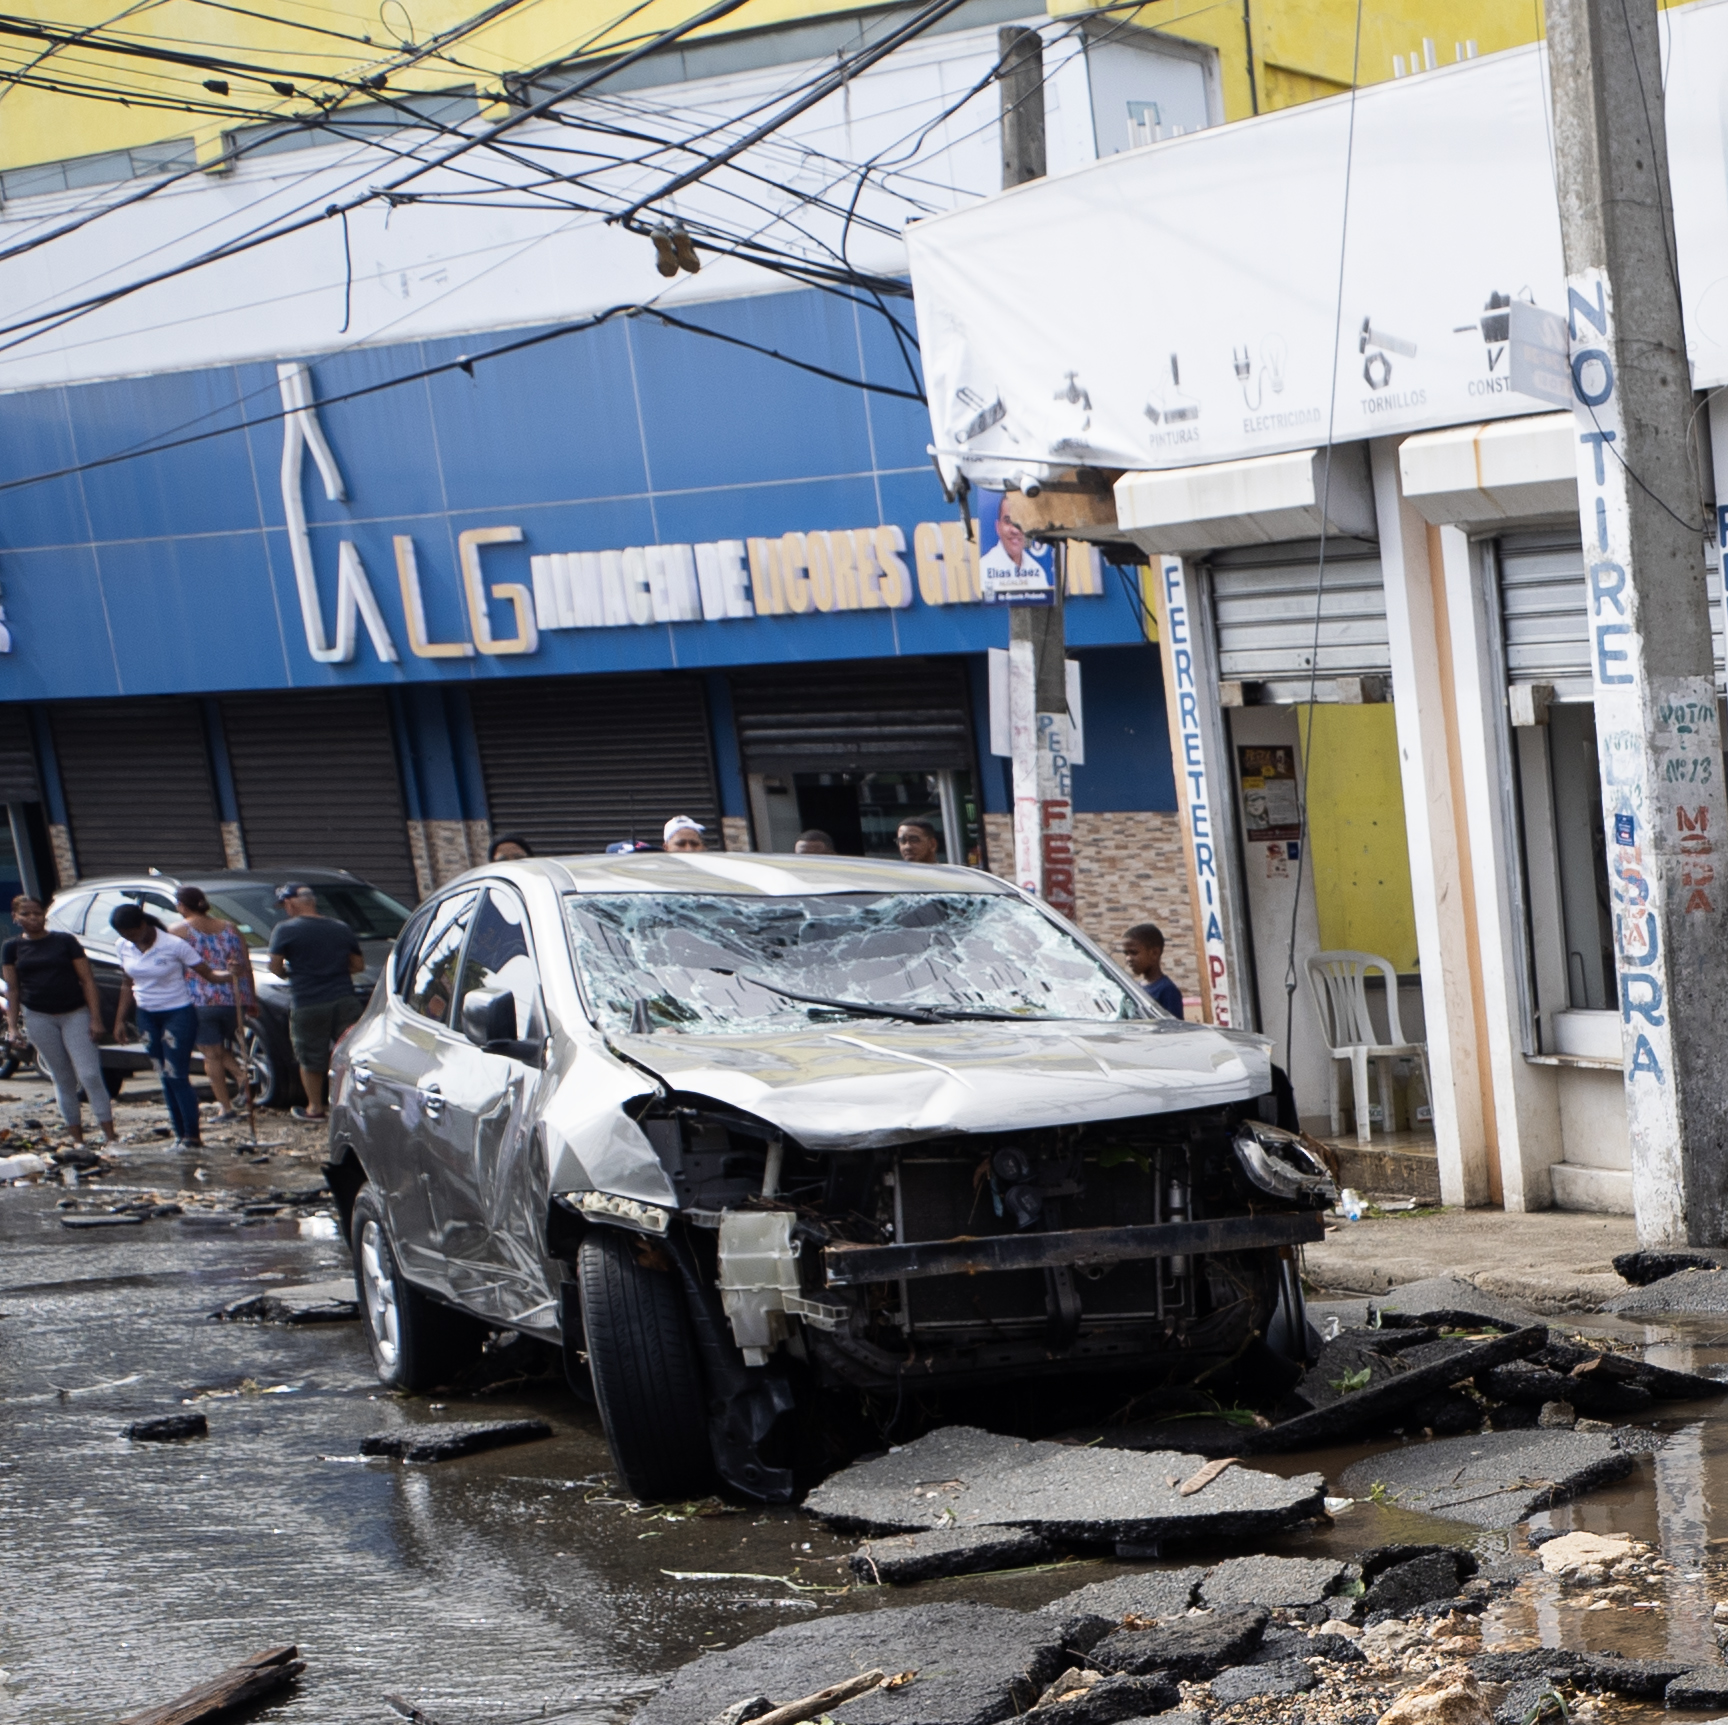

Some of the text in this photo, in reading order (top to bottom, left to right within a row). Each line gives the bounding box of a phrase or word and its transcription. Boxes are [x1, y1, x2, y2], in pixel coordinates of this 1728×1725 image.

[1361, 390, 1427, 415] TORNILLOS
[1243, 408, 1321, 433] ELECTRICIDAD
[1149, 427, 1200, 447] PINTURAS
[530, 543, 701, 631] ALMACEN
[694, 539, 755, 621] DE
[746, 524, 911, 616] LICORES
[1164, 565, 1224, 944] FERRETERIA
